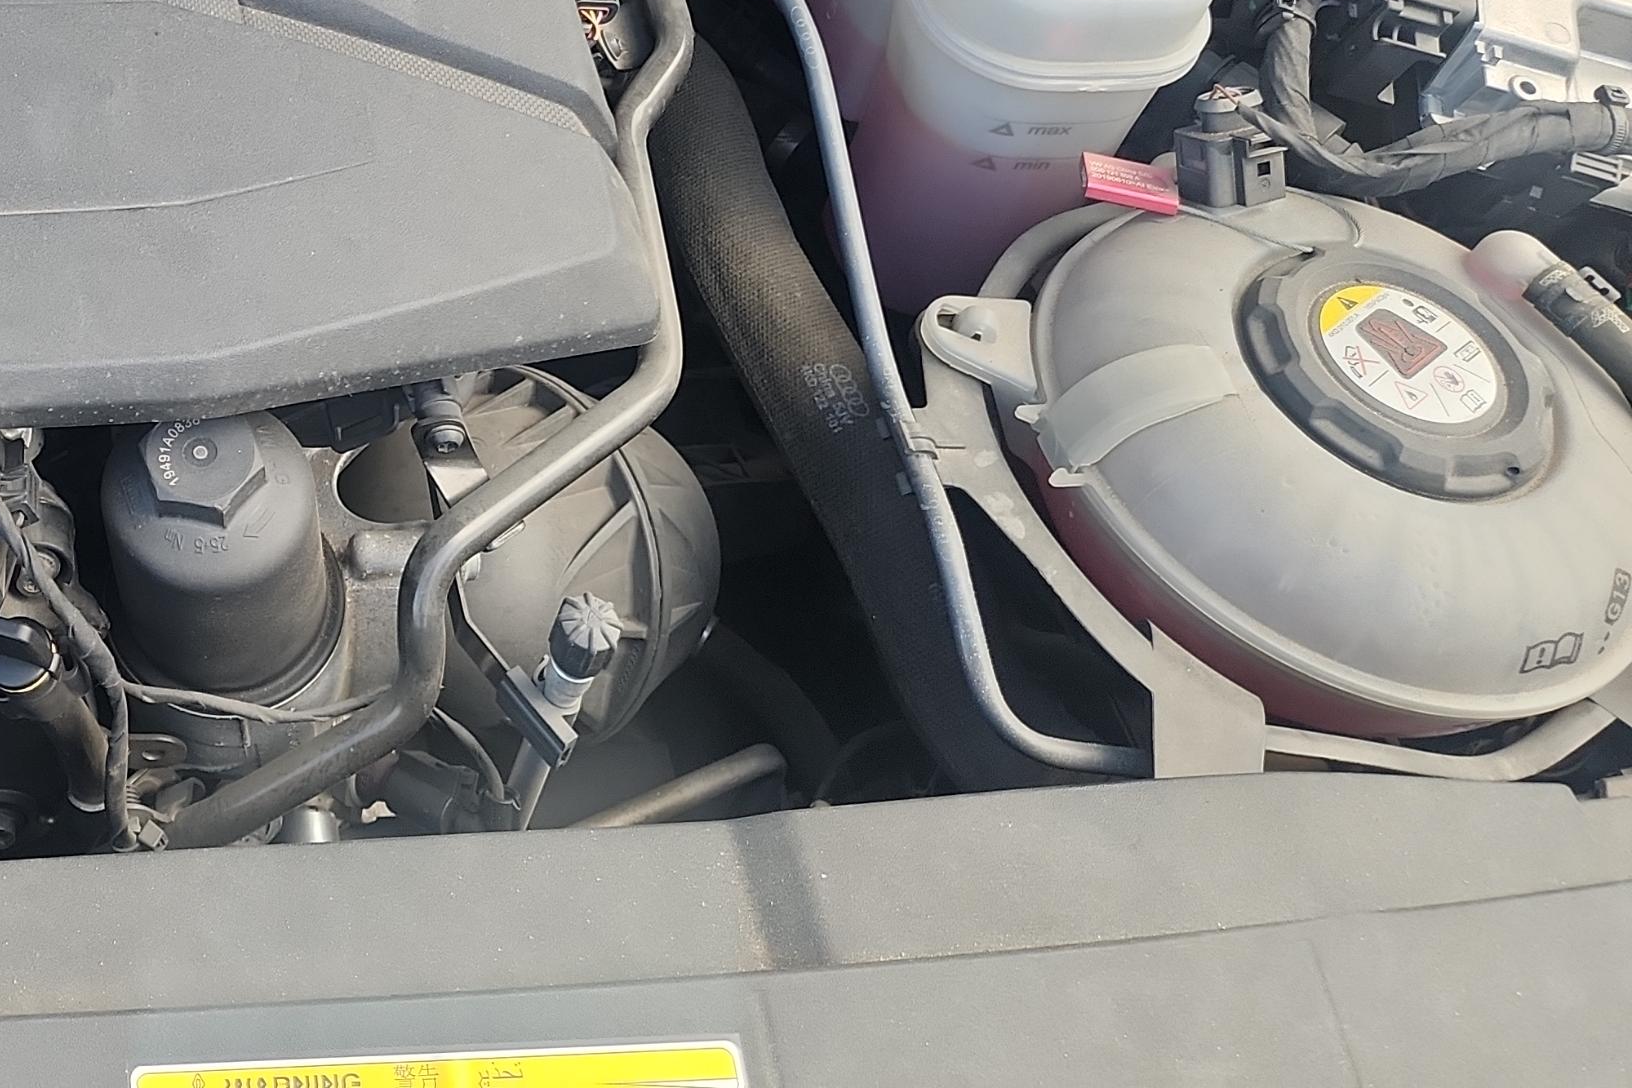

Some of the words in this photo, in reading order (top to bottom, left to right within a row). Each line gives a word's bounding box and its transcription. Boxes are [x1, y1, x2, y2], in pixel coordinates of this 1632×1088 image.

[1028, 126, 1073, 136] max
[1012, 159, 1051, 171] min
[1606, 572, 1630, 622] G13
